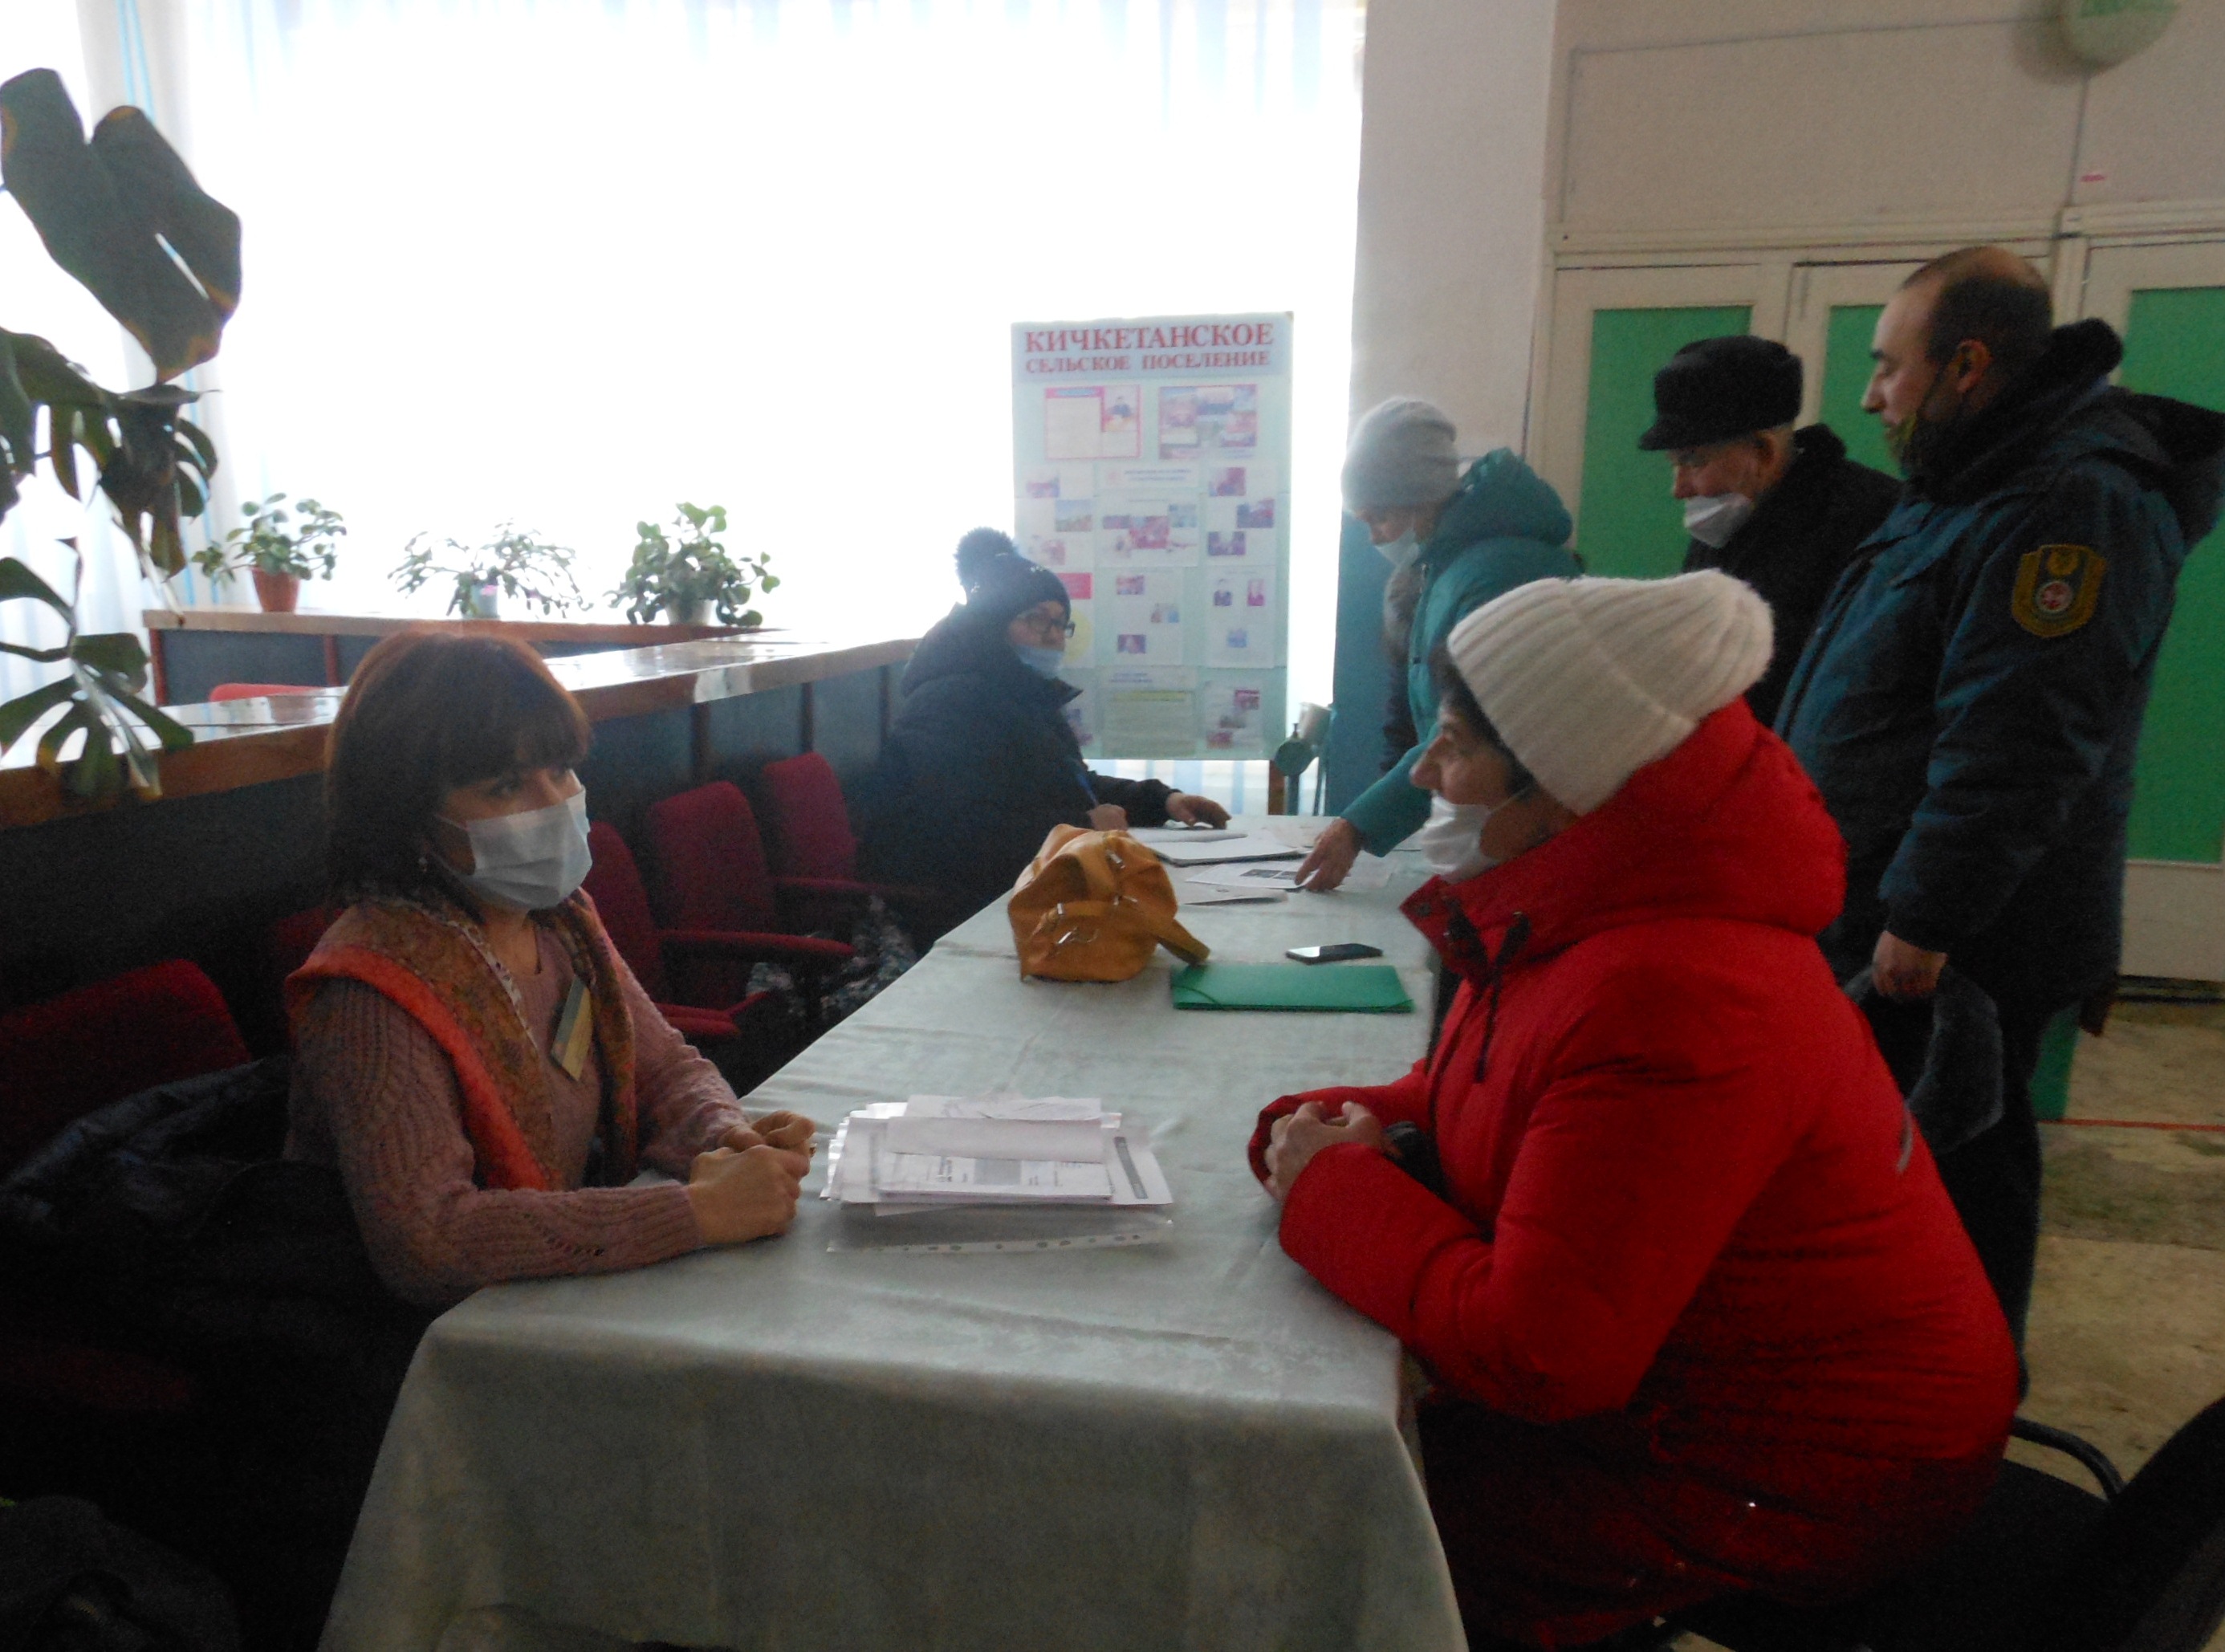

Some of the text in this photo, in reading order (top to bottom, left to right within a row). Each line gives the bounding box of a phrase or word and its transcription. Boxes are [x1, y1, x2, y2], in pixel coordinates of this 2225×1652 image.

[1025, 323, 1275, 353] КИЧКЕТАНСКОЕ
[1026, 351, 1271, 373] СЕЛЬСКОЕ ПОСЕЛЕНИЕ
